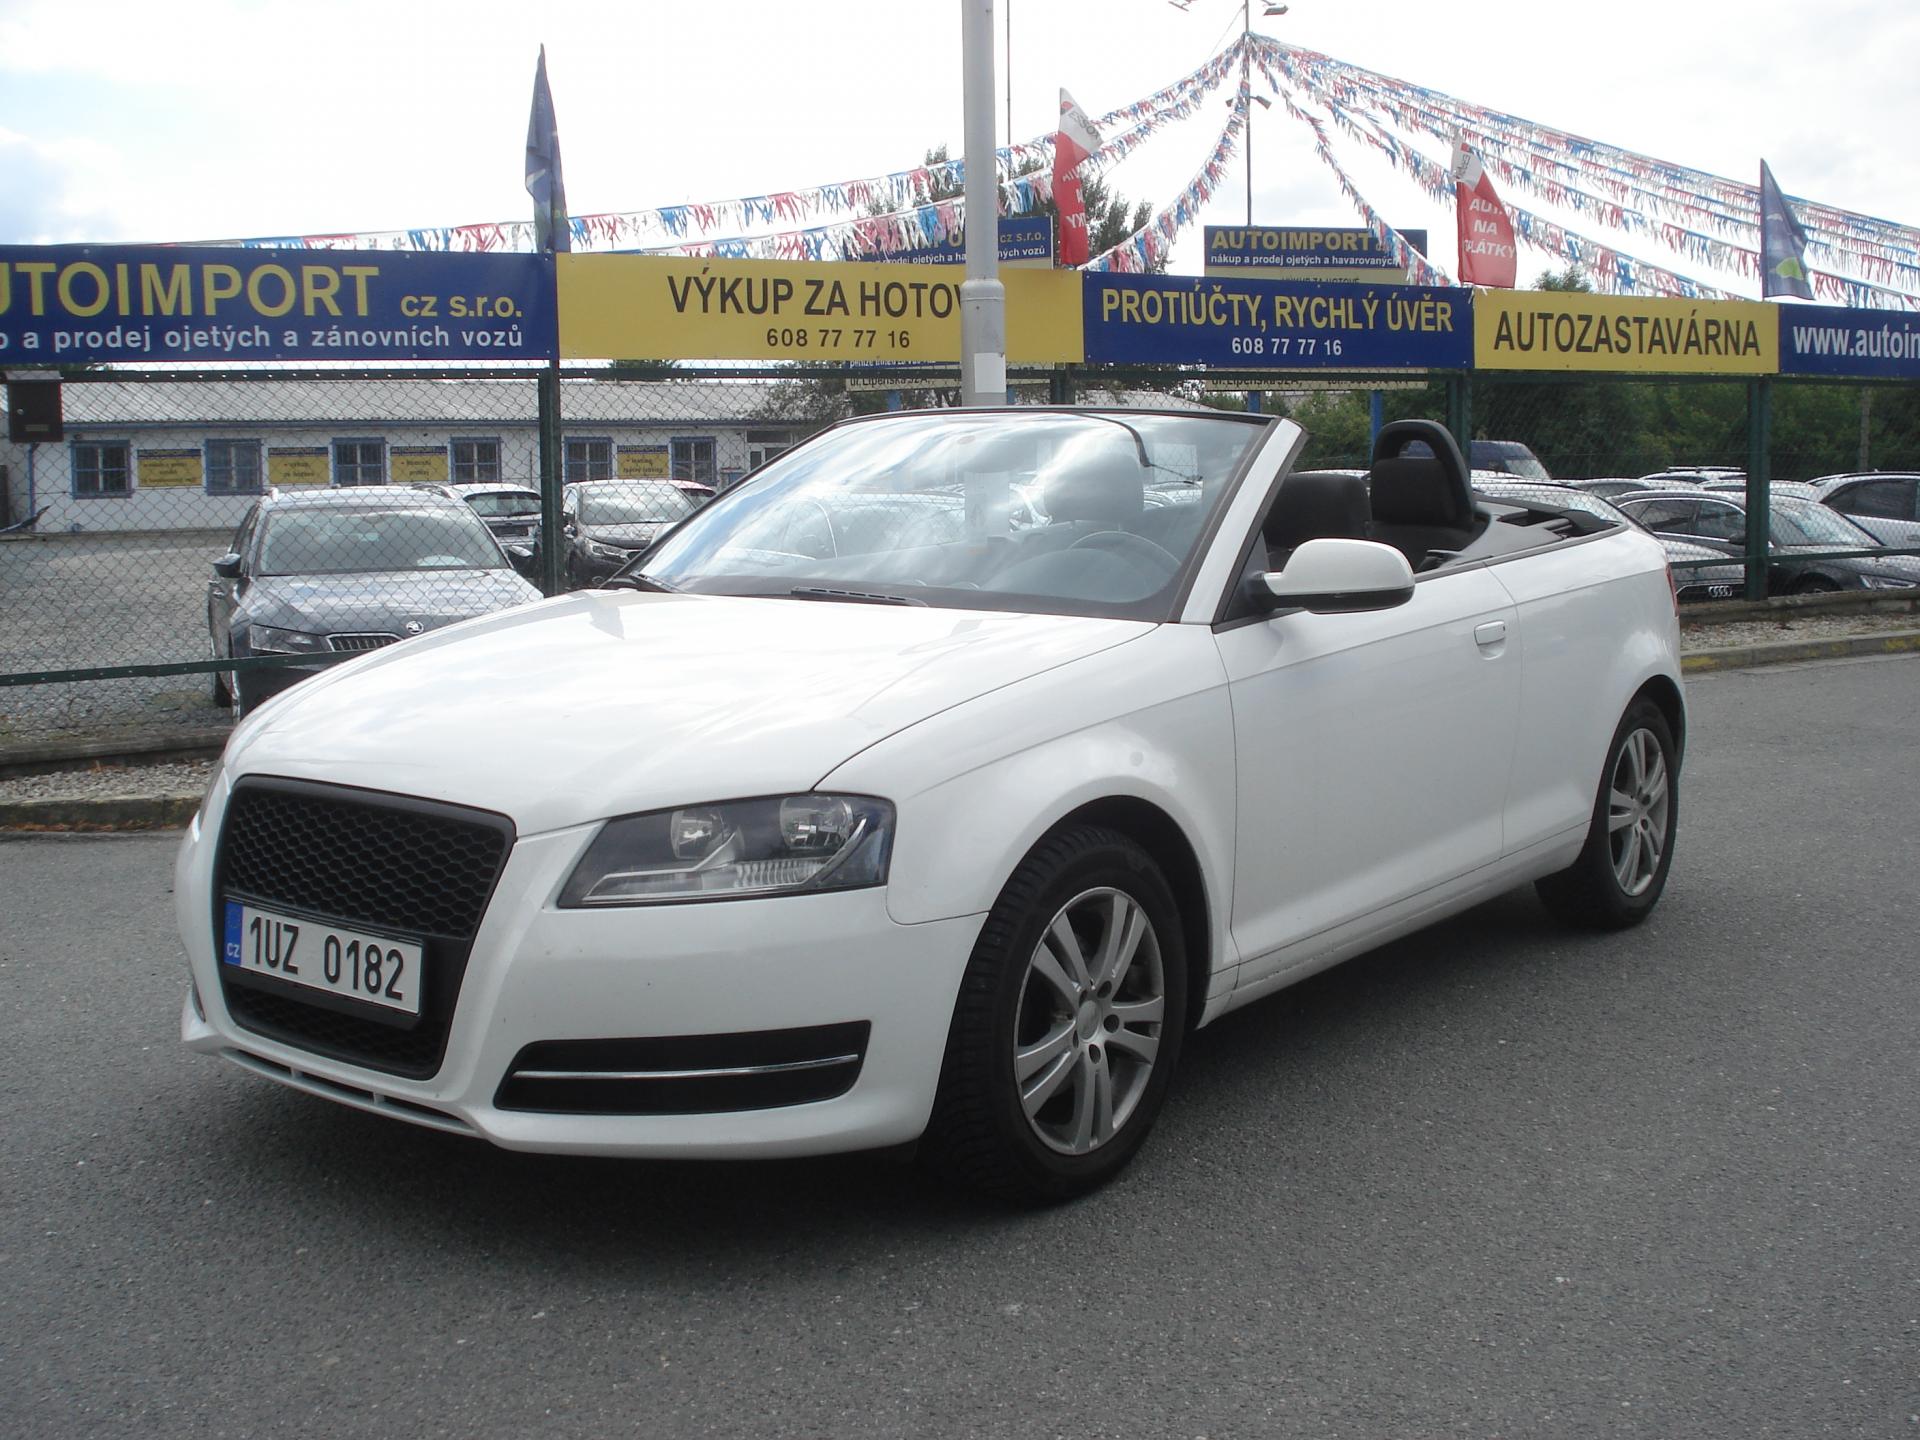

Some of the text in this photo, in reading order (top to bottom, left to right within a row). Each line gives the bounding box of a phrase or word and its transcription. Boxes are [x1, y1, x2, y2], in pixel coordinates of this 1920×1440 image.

[1016, 232, 1046, 242] s.r.o.
[1474, 219, 1498, 235] NA
[1022, 245, 1045, 256] vozů
[1212, 230, 1369, 251] AUTOIMPORT
[1211, 254, 1241, 265] nákup
[1252, 255, 1284, 266] prodej
[1286, 255, 1322, 266] ojetých
[666, 266, 794, 316] VÝKUP
[804, 279, 850, 316] ZA
[400, 295, 438, 317] cz
[448, 296, 522, 318] s.r.o.
[1102, 284, 1454, 333] PROTIÚČTY, RYCHLÝ ÚVĚR
[23, 331, 40, 349] a
[54, 324, 150, 353] prodej
[164, 325, 270, 352] ojetých
[283, 330, 299, 347] a
[311, 325, 449, 347] zánovních
[461, 324, 522, 347] vozů
[766, 328, 911, 349] 608 77 77 16
[1493, 309, 1761, 357] AUTOZASTAVÁRNA
[1231, 337, 1343, 356] 608 77 77 16
[226, 942, 240, 958] CZ
[250, 916, 404, 1001] 1UZ 0182
